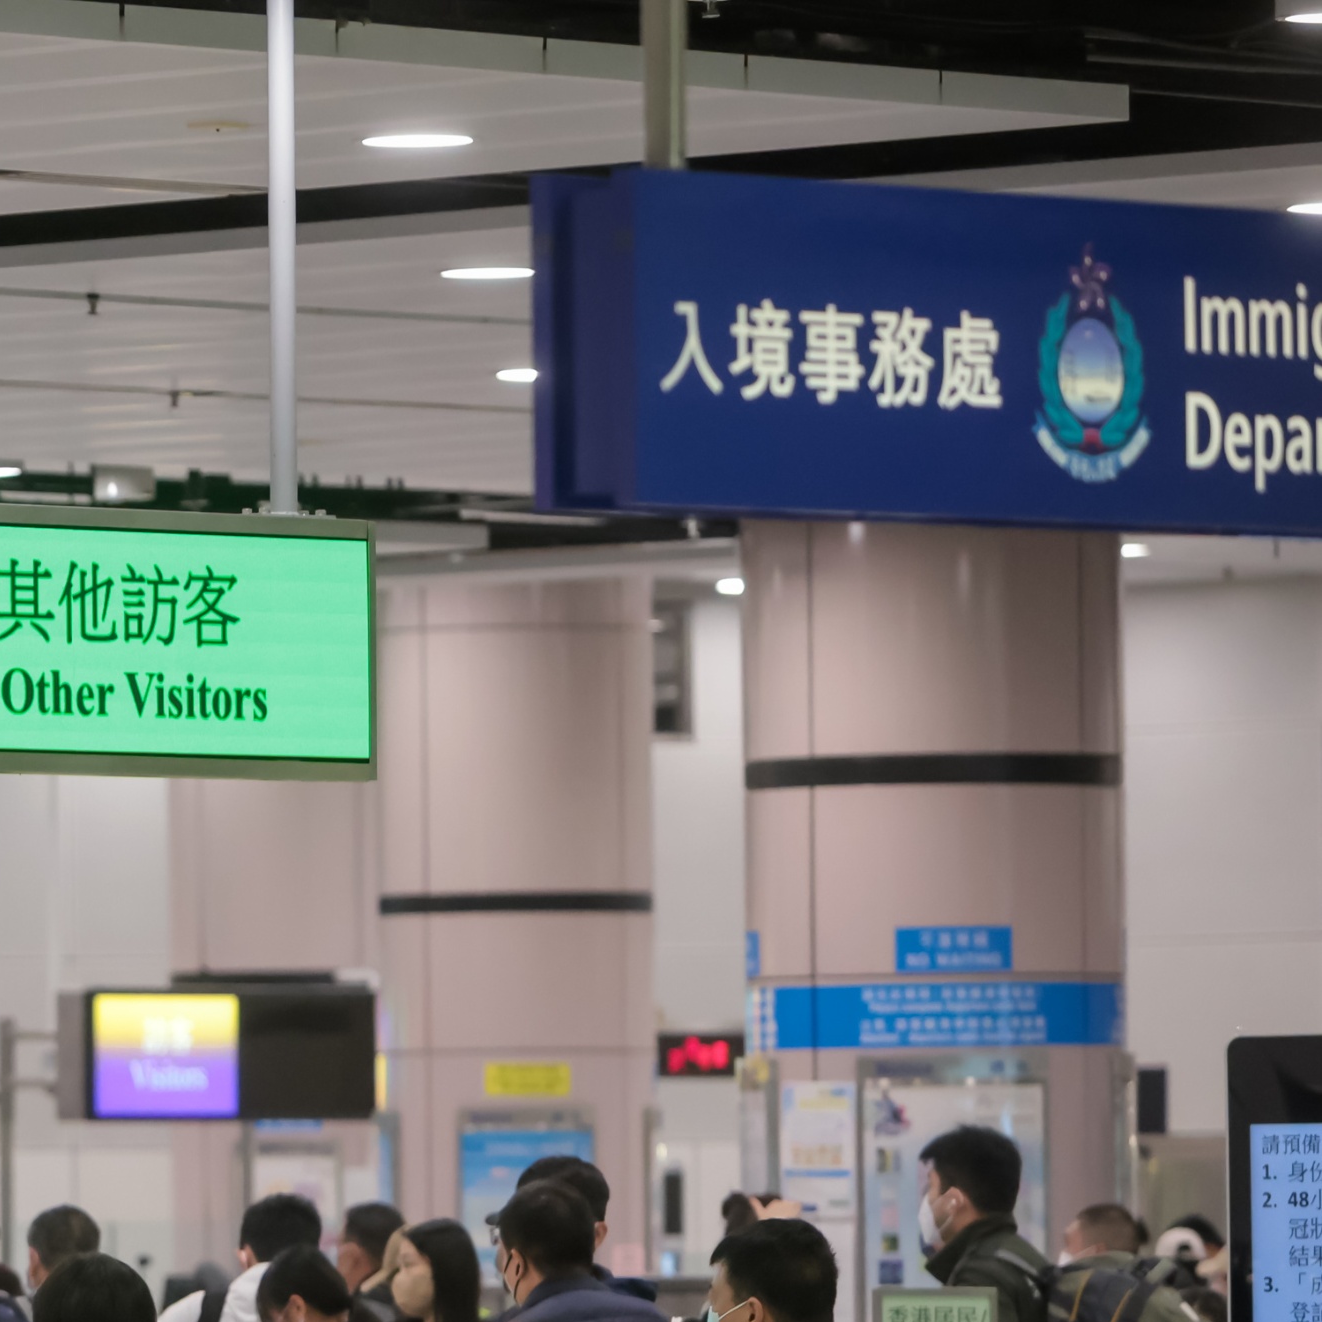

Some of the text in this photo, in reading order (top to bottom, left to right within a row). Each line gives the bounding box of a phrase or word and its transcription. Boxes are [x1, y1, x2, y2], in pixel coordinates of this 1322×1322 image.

[659, 298, 1004, 411] 入境事務處
[1, 666, 116, 717] Other
[125, 671, 269, 723] Visitors
[1262, 1164, 1277, 1180] 1.
[1262, 1191, 1277, 1208] 2.
[1263, 1276, 1279, 1293] 3.
